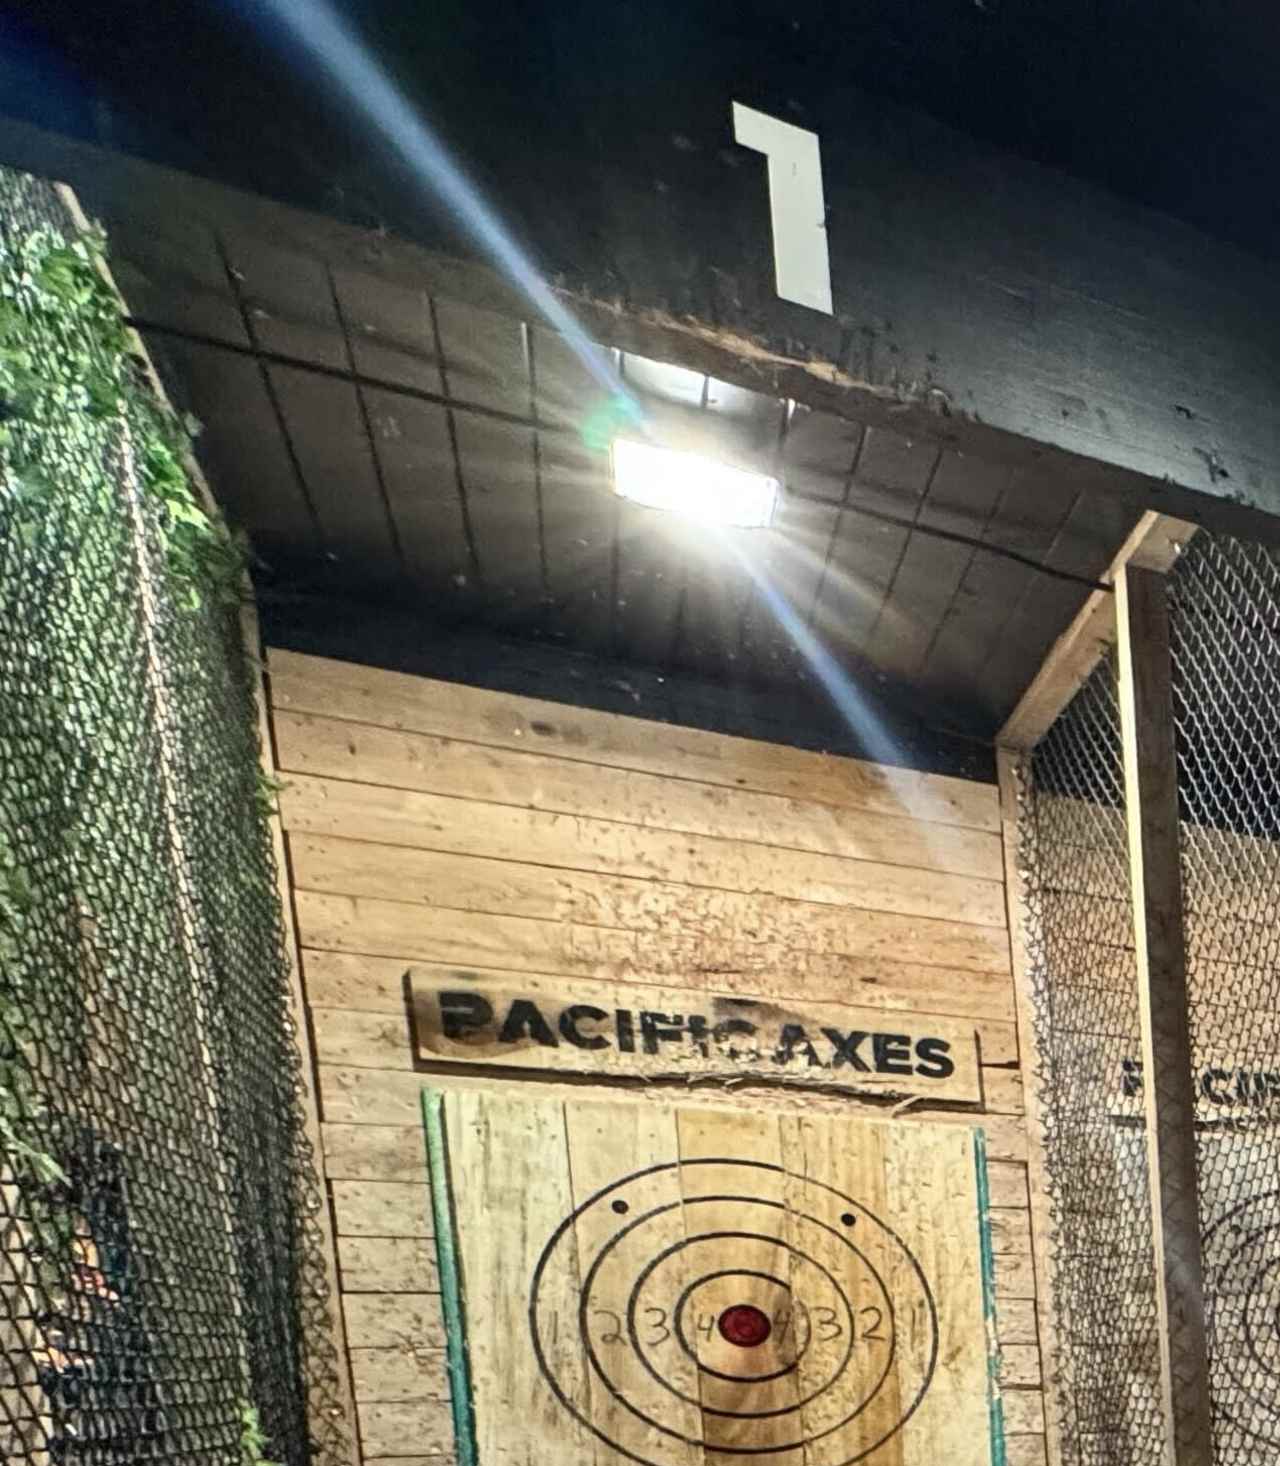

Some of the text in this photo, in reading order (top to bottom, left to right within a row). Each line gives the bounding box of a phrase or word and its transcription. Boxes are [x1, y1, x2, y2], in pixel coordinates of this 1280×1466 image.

[733, 101, 833, 314] 1
[438, 990, 955, 1081] PACIFIC AXES
[593, 1310, 628, 1346] 2
[645, 1307, 670, 1346] 3
[696, 1314, 716, 1343] 4
[773, 1309, 793, 1345] 4
[812, 1307, 842, 1342] 3
[860, 1306, 886, 1341] 2
